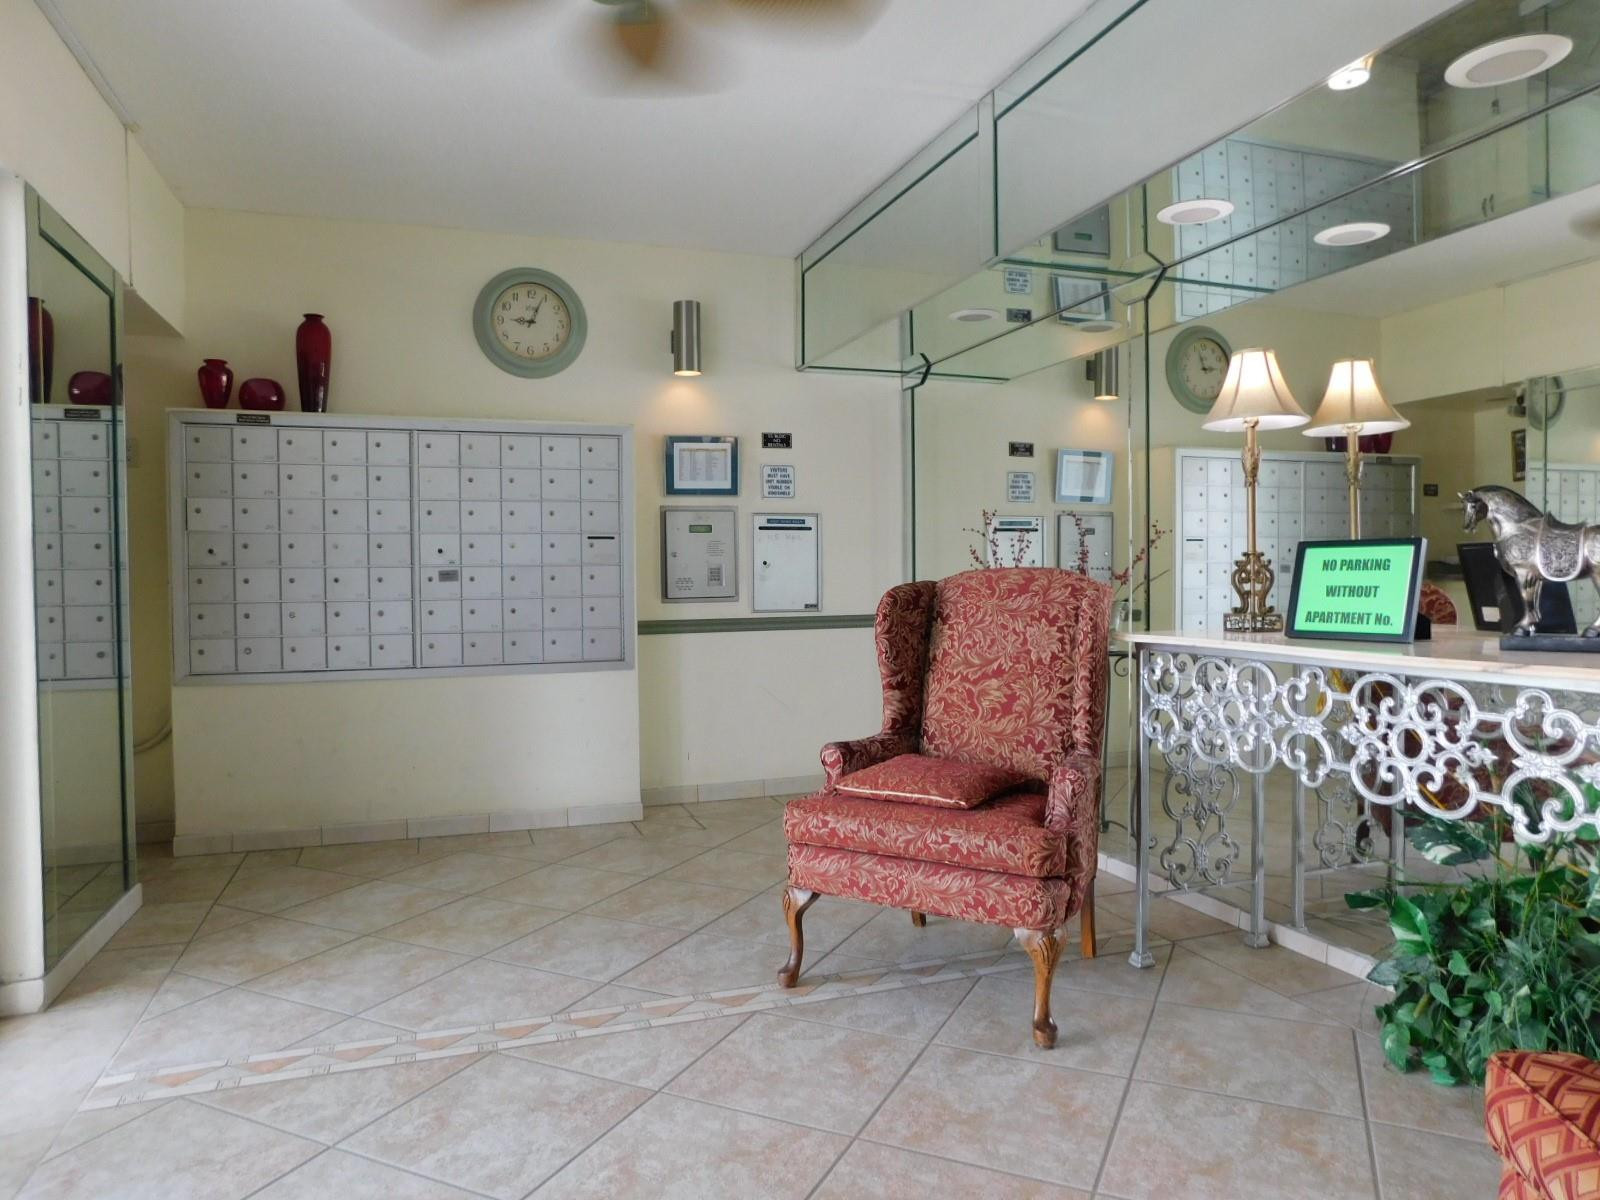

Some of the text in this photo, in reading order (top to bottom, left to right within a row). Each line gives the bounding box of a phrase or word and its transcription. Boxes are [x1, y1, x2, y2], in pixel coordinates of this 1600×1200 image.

[512, 292, 519, 302] 11
[527, 289, 537, 299] 12
[501, 302, 512, 312] 10
[553, 304, 561, 315] 2
[496, 315, 505, 326] 9
[557, 319, 565, 329] 3
[512, 341, 521, 351] 7
[527, 345, 535, 355] 6
[543, 342, 550, 352] 5
[1322, 558, 1392, 572] NO PARKING
[1325, 585, 1380, 598] WITHOUT
[1304, 610, 1393, 626] APARTMENT No.
